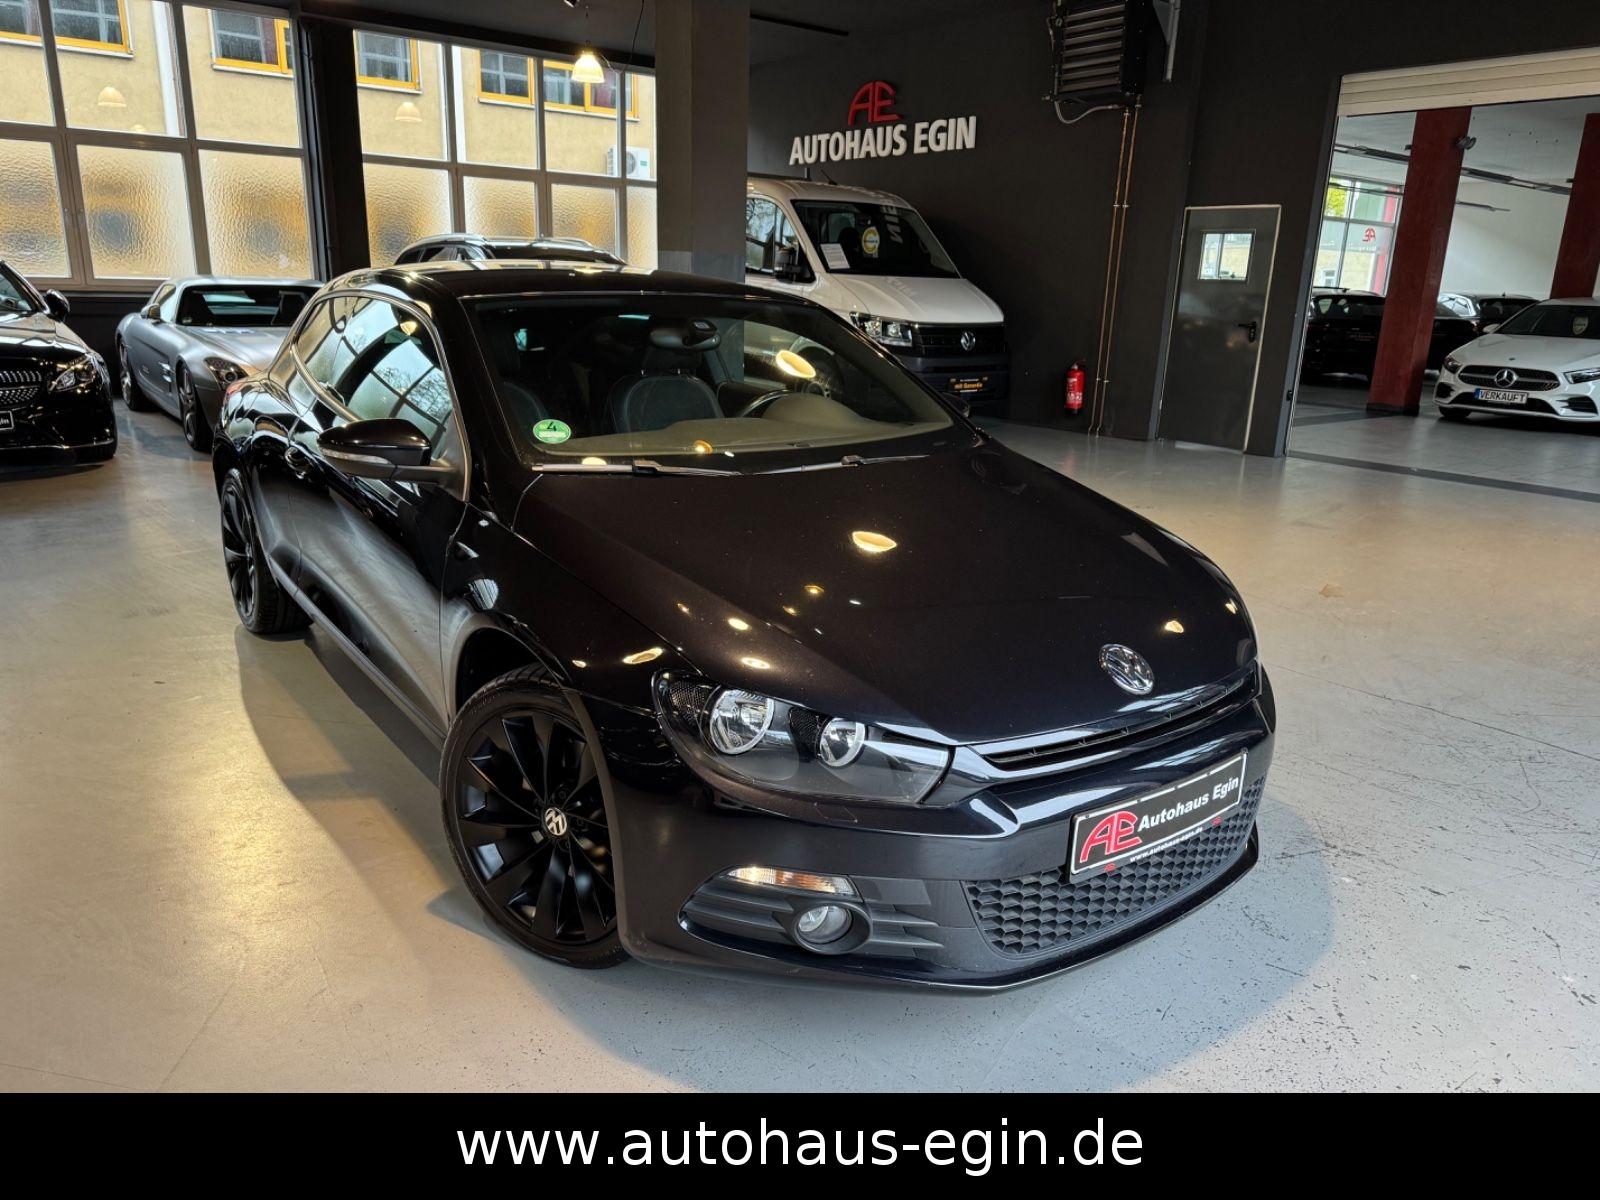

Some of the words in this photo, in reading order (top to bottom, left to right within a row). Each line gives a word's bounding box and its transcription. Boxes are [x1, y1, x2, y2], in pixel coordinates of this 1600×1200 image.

[848, 80, 901, 126] AE
[789, 124, 908, 166] AUTOHAUS
[913, 115, 977, 154] EGIN
[1480, 391, 1525, 402] VERKAUFT
[547, 421, 557, 431] 4
[1079, 811, 1143, 863] AE
[1137, 792, 1209, 832] Autohaus
[1212, 776, 1240, 800] Egin
